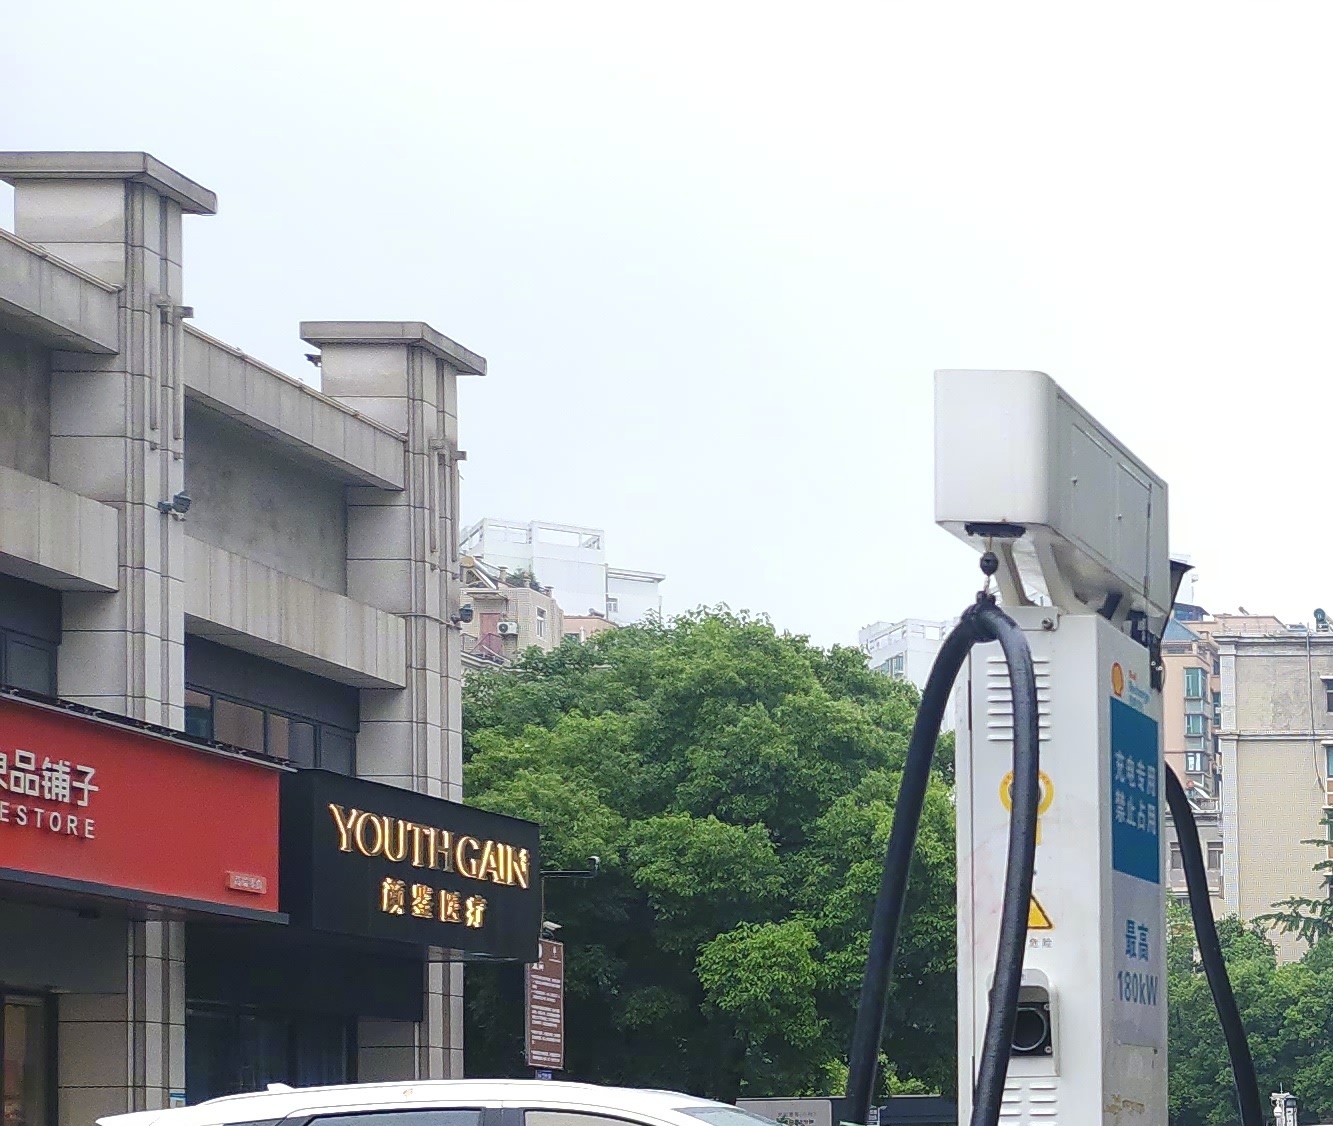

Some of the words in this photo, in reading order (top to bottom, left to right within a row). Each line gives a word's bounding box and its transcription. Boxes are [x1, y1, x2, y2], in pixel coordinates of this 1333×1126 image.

[0, 749, 100, 807] 品铺子
[327, 802, 455, 873] YOUTH
[455, 835, 531, 889] GAIN
[1125, 919, 1149, 962] 最高
[1117, 970, 1158, 1006] 180kW
